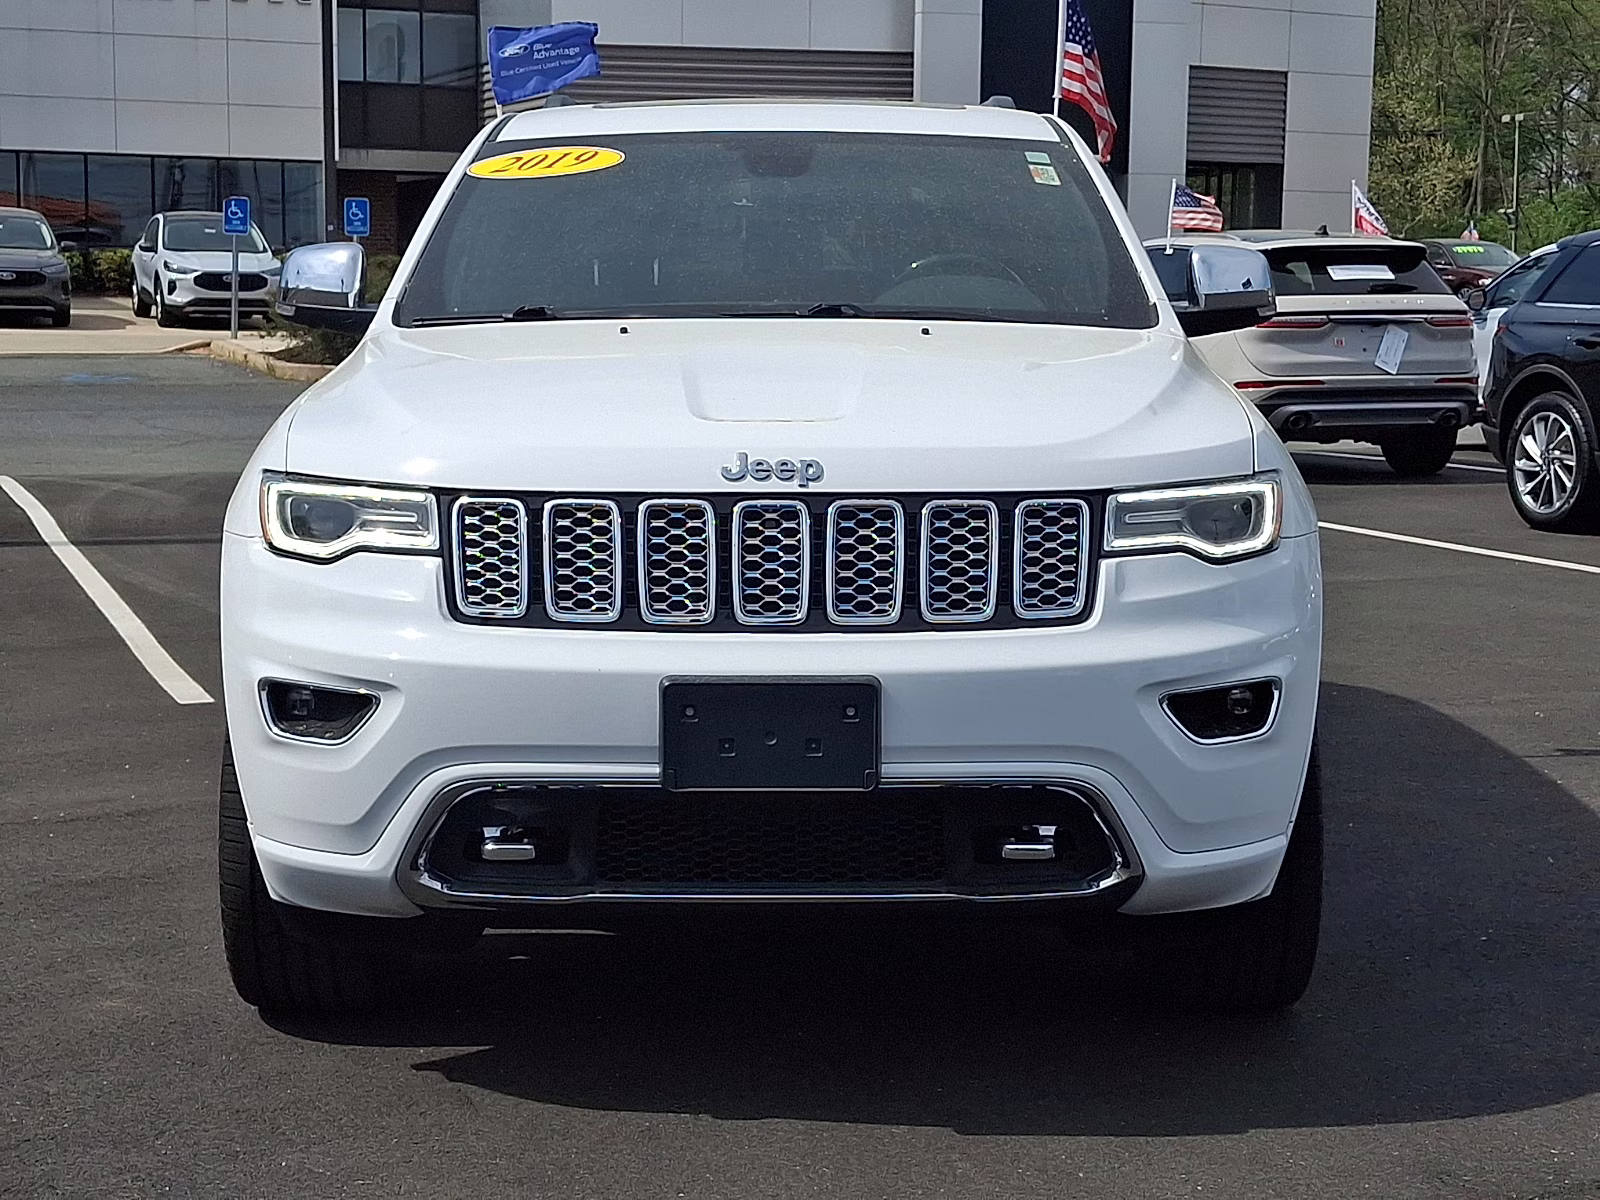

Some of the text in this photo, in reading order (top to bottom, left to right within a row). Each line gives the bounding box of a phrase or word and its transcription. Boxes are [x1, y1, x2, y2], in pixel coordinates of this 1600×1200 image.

[533, 47, 580, 60] Advantage
[488, 151, 599, 173] 2019
[721, 452, 824, 488] Jeep
